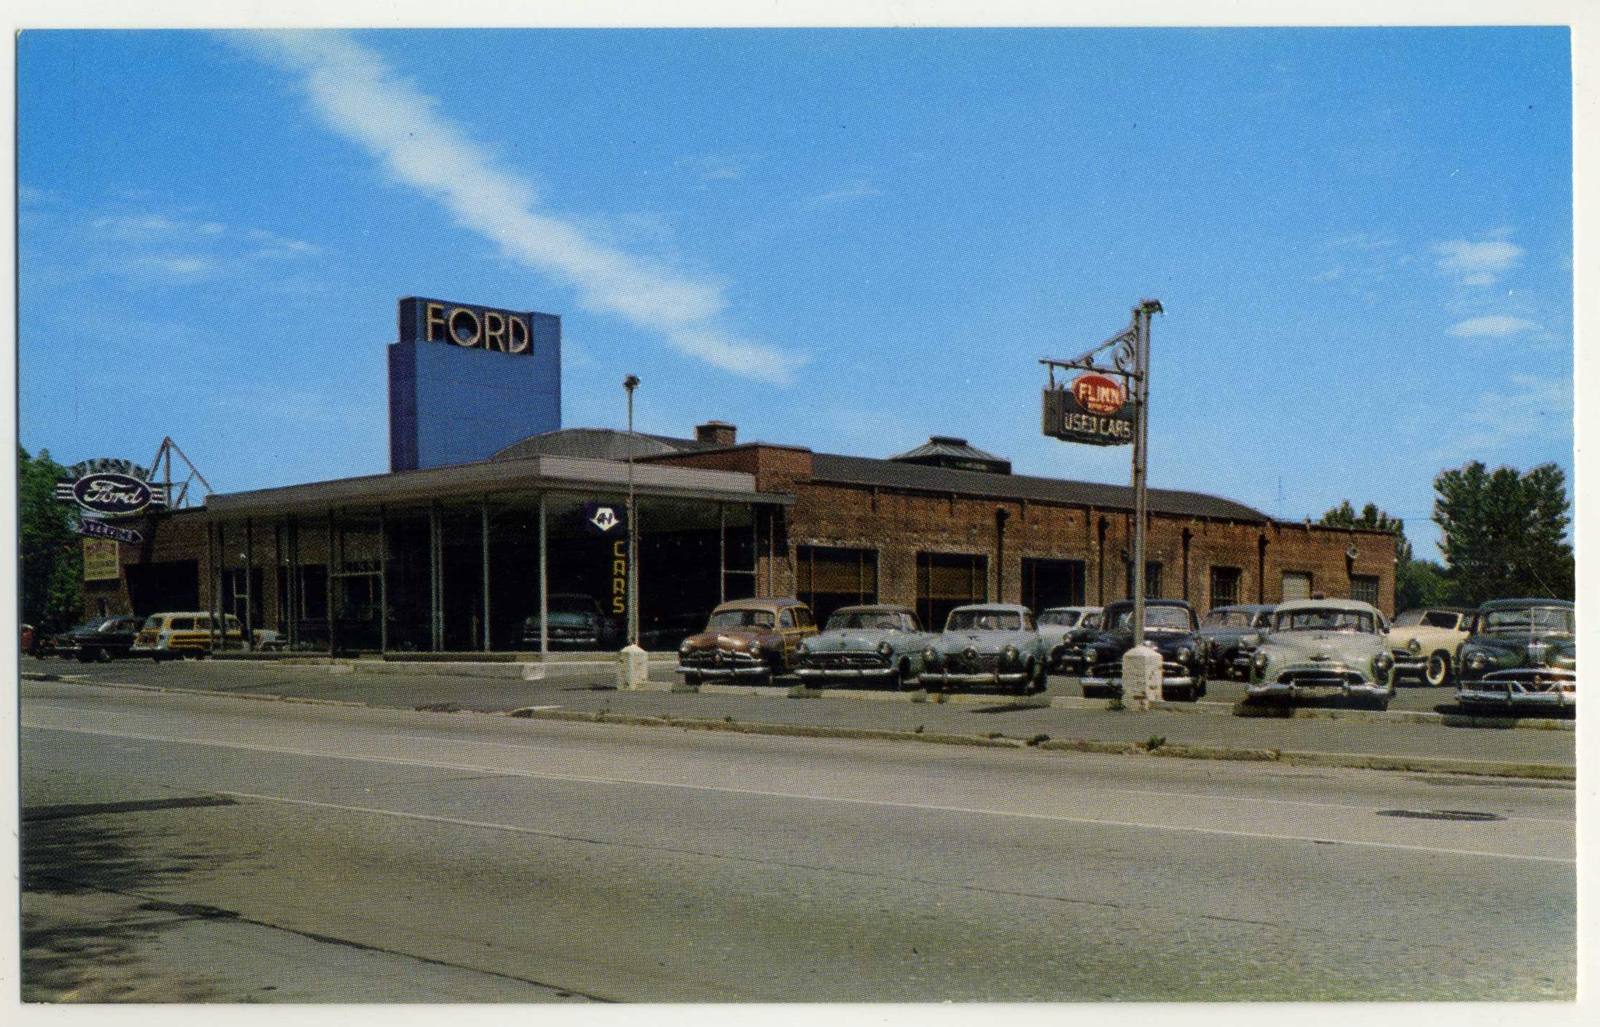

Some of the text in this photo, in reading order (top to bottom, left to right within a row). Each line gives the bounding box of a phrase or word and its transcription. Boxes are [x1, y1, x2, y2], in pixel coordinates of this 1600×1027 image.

[426, 302, 529, 353] FORD
[1079, 383, 1120, 406] FLINN
[1064, 413, 1131, 438] USED CARS
[83, 480, 143, 504] Ford
[612, 540, 626, 614] CARS
